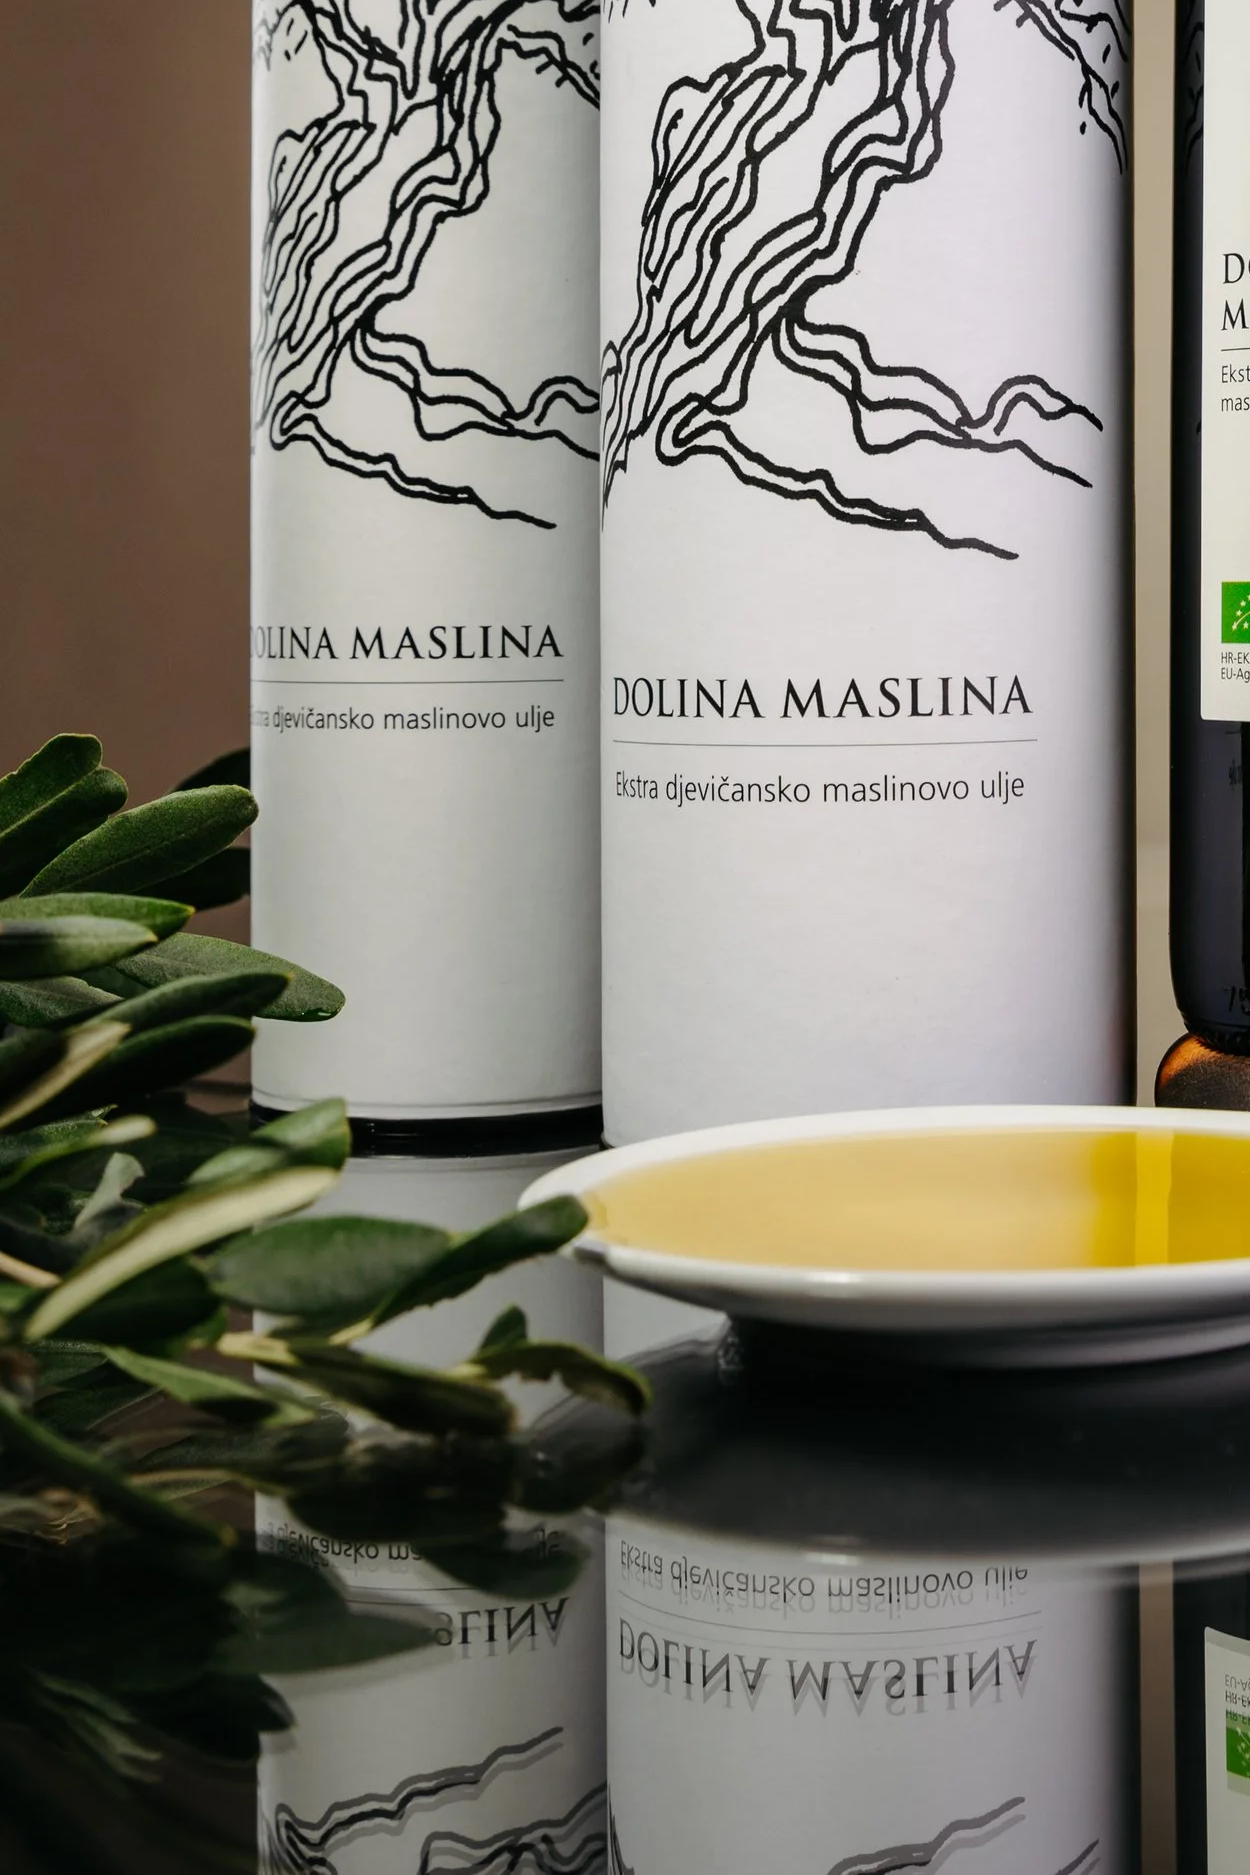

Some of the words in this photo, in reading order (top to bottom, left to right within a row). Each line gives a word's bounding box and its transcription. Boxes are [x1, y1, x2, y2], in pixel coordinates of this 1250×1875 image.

[350, 624, 565, 659] MASLINA
[613, 677, 766, 718] DOLINA
[780, 675, 1034, 718] MASLINA
[272, 706, 375, 733] djevičansko
[384, 707, 506, 730] maslinovo
[516, 705, 556, 733] ulje
[616, 771, 658, 800] Ekstra
[666, 773, 811, 808] djevičansko
[823, 775, 969, 803] maslinovo
[981, 771, 1025, 805] ulje
